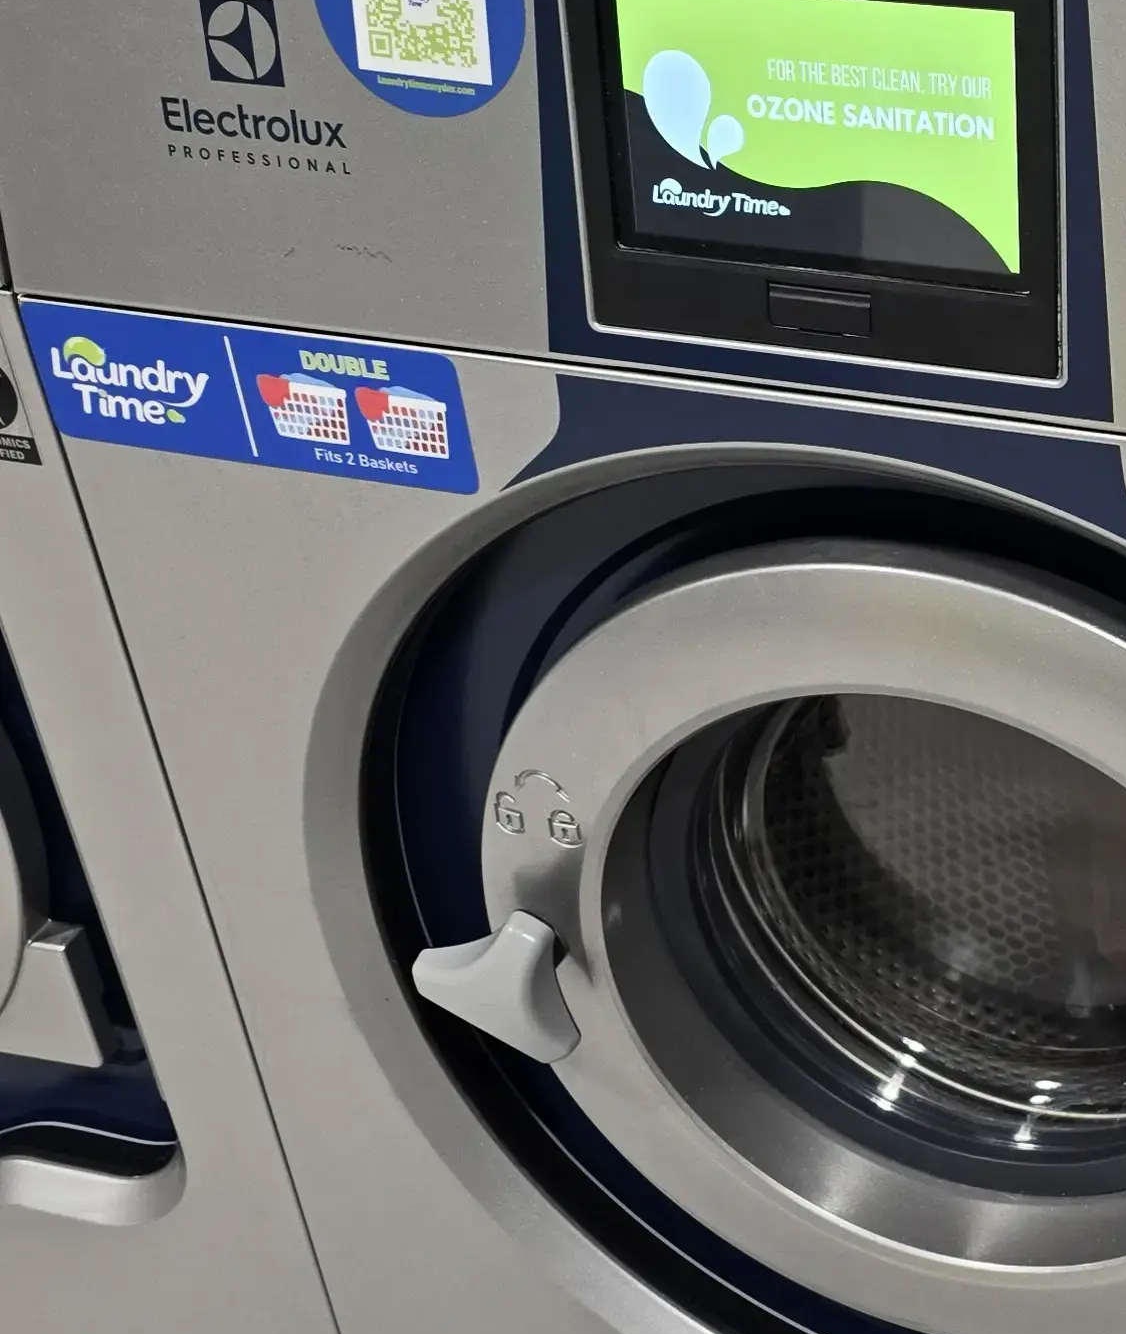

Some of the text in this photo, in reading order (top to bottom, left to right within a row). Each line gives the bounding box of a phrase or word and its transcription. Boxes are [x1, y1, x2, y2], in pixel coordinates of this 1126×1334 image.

[767, 58, 796, 82] FOR
[800, 61, 828, 85] THE
[830, 64, 868, 89] BEST
[928, 73, 959, 96] TRY
[961, 75, 992, 100] OUR
[160, 96, 347, 149] Electrolux
[746, 94, 995, 140] OZONE SANITATION
[168, 144, 351, 175] PROFESSIONAL
[653, 180, 779, 216] Laundry Time
[51, 345, 210, 408] Laundry
[299, 349, 391, 381] DOUBLE
[73, 383, 166, 425] Time
[314, 447, 419, 475] Fits 2 Baskets
